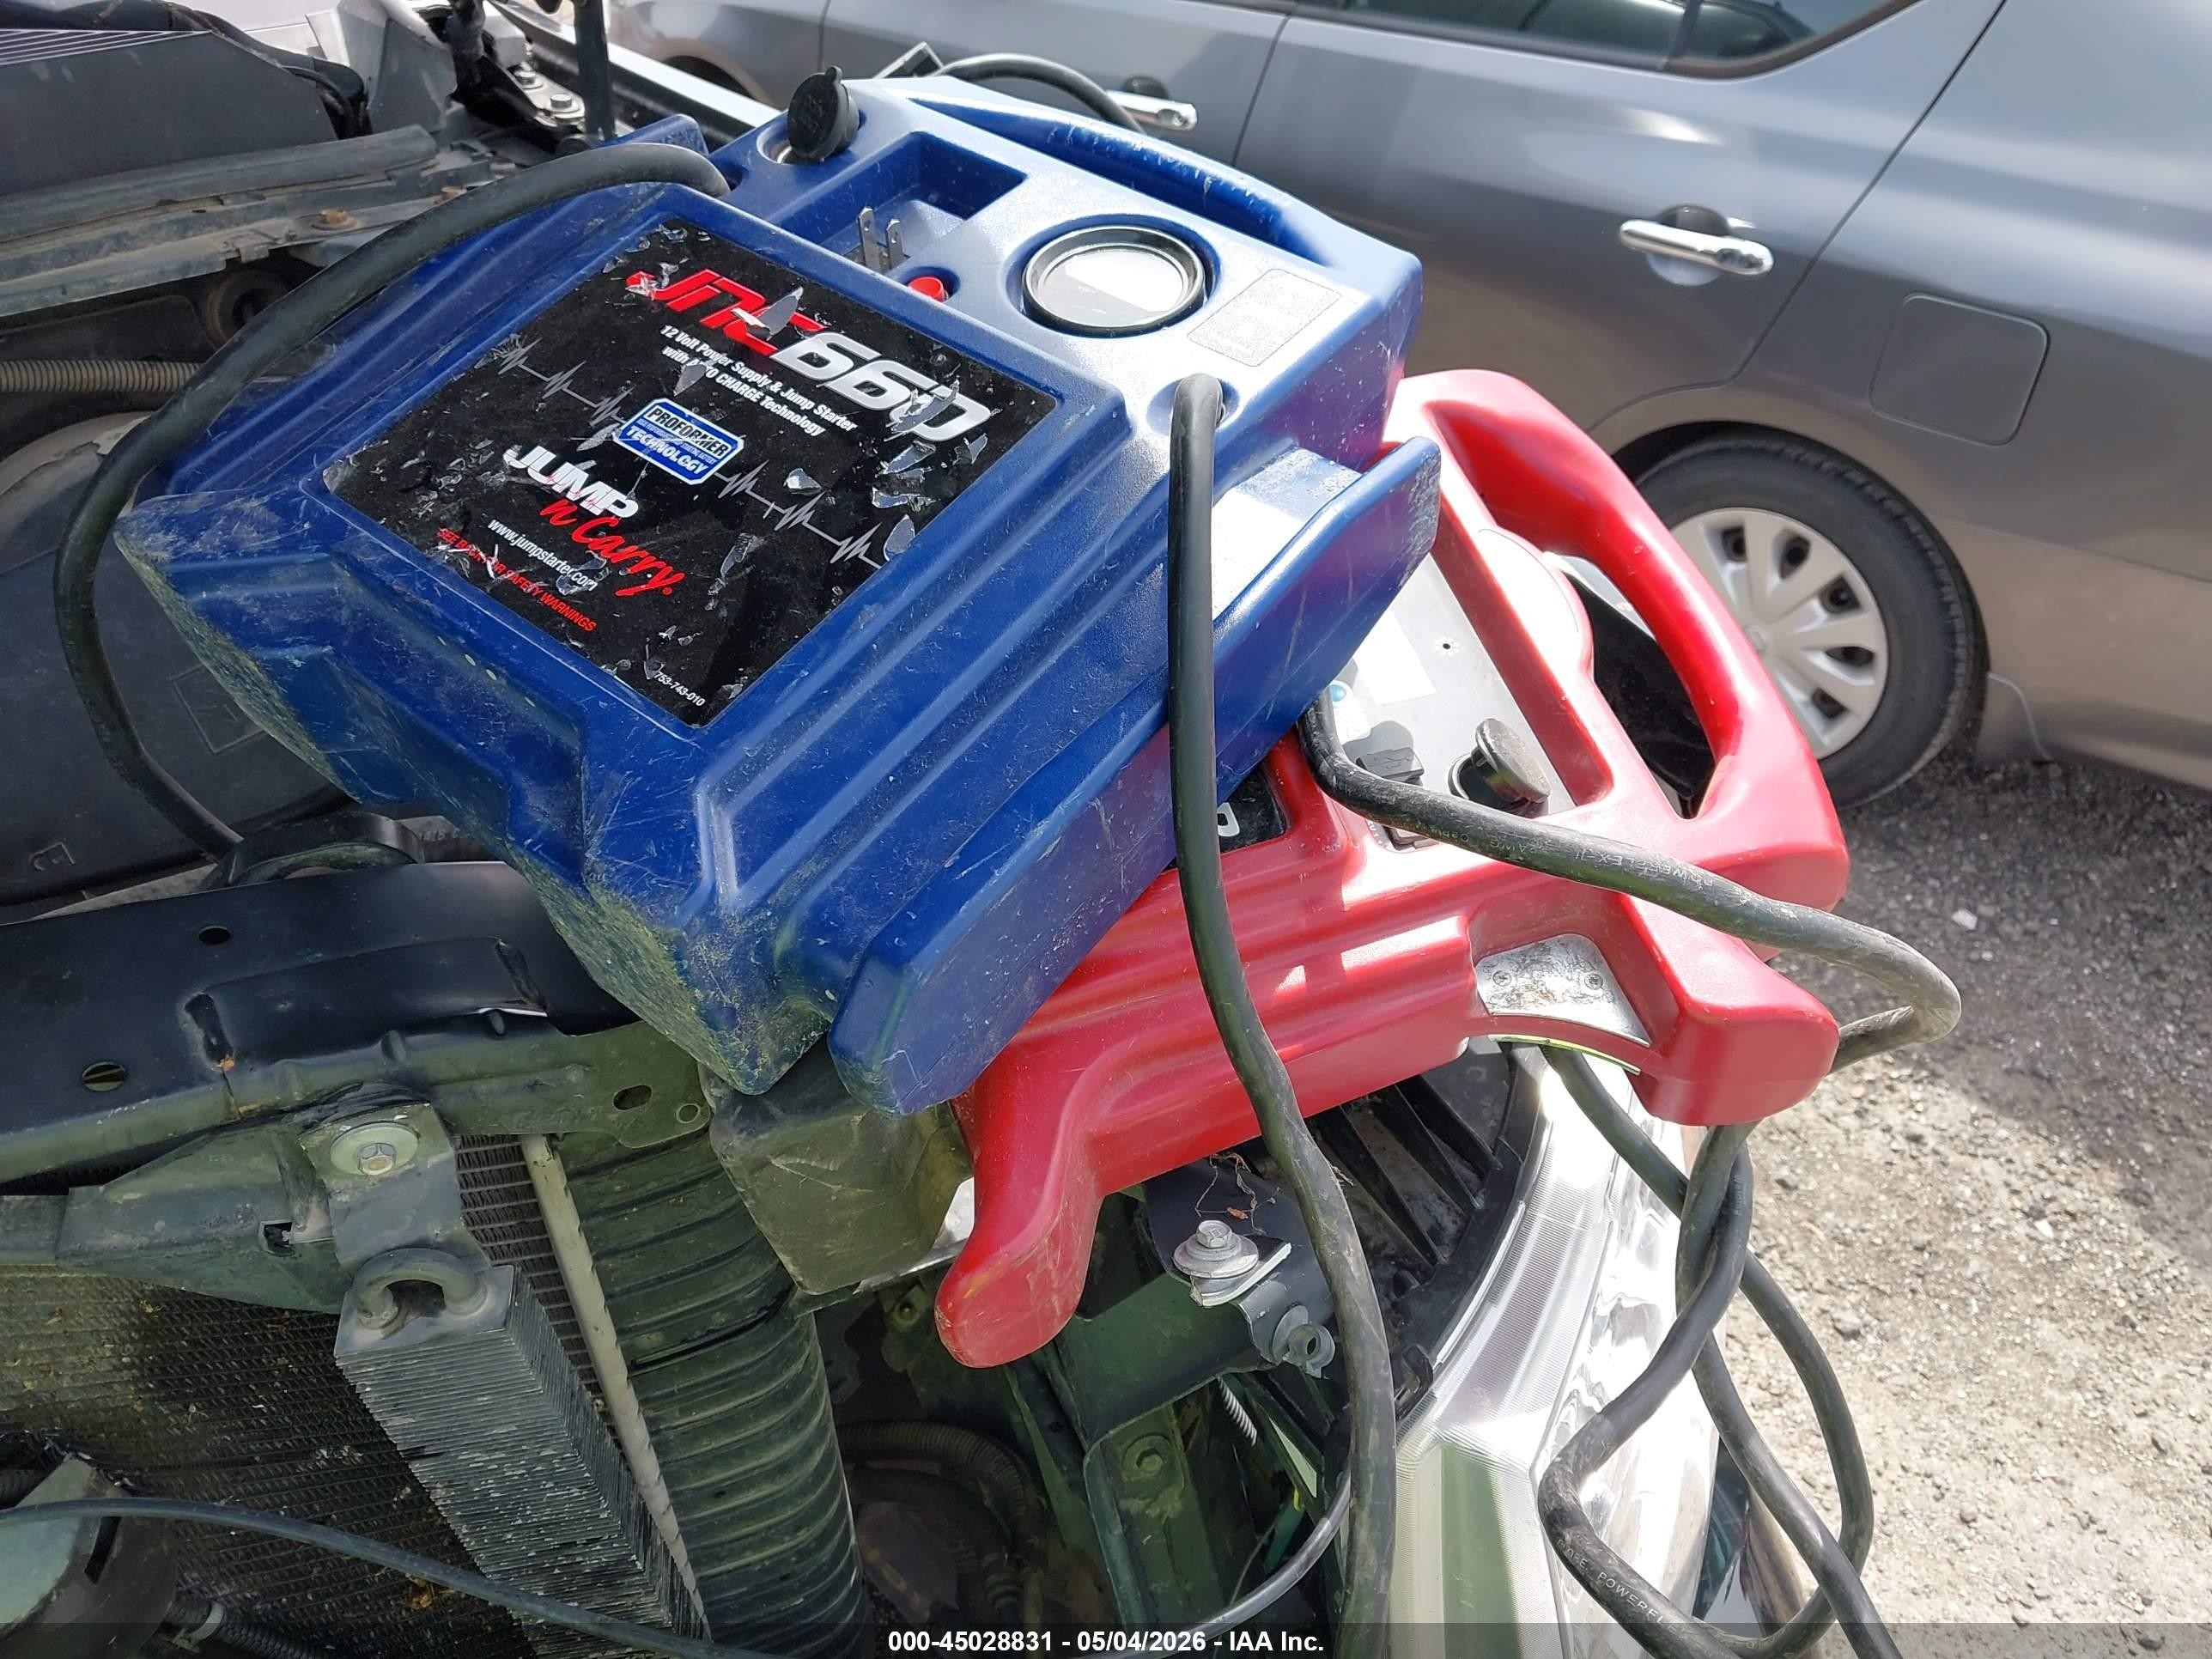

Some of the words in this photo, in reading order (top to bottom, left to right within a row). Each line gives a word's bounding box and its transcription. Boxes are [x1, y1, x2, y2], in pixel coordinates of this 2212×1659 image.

[660, 325, 676, 338] 12
[674, 330, 699, 350] Volt
[697, 343, 733, 368] Power
[731, 361, 772, 390] Supply
[770, 380, 783, 393] &
[780, 387, 816, 411] Jump
[813, 402, 857, 432] Starter
[661, 346, 689, 366] with
[688, 358, 715, 380] ATO
[714, 372, 762, 403] CHARGE
[759, 392, 826, 436] Technology
[626, 425, 709, 475] TECHNOLOGY
[647, 408, 729, 457] PROFORMER
[502, 445, 639, 518] JUMP
[539, 498, 578, 526] n
[436, 527, 459, 544] SEE
[504, 569, 544, 598] SAFETY
[540, 592, 598, 632] WARNINGS
[487, 519, 599, 592] www.jumpstarter.com
[653, 671, 706, 707] 753-743-010
